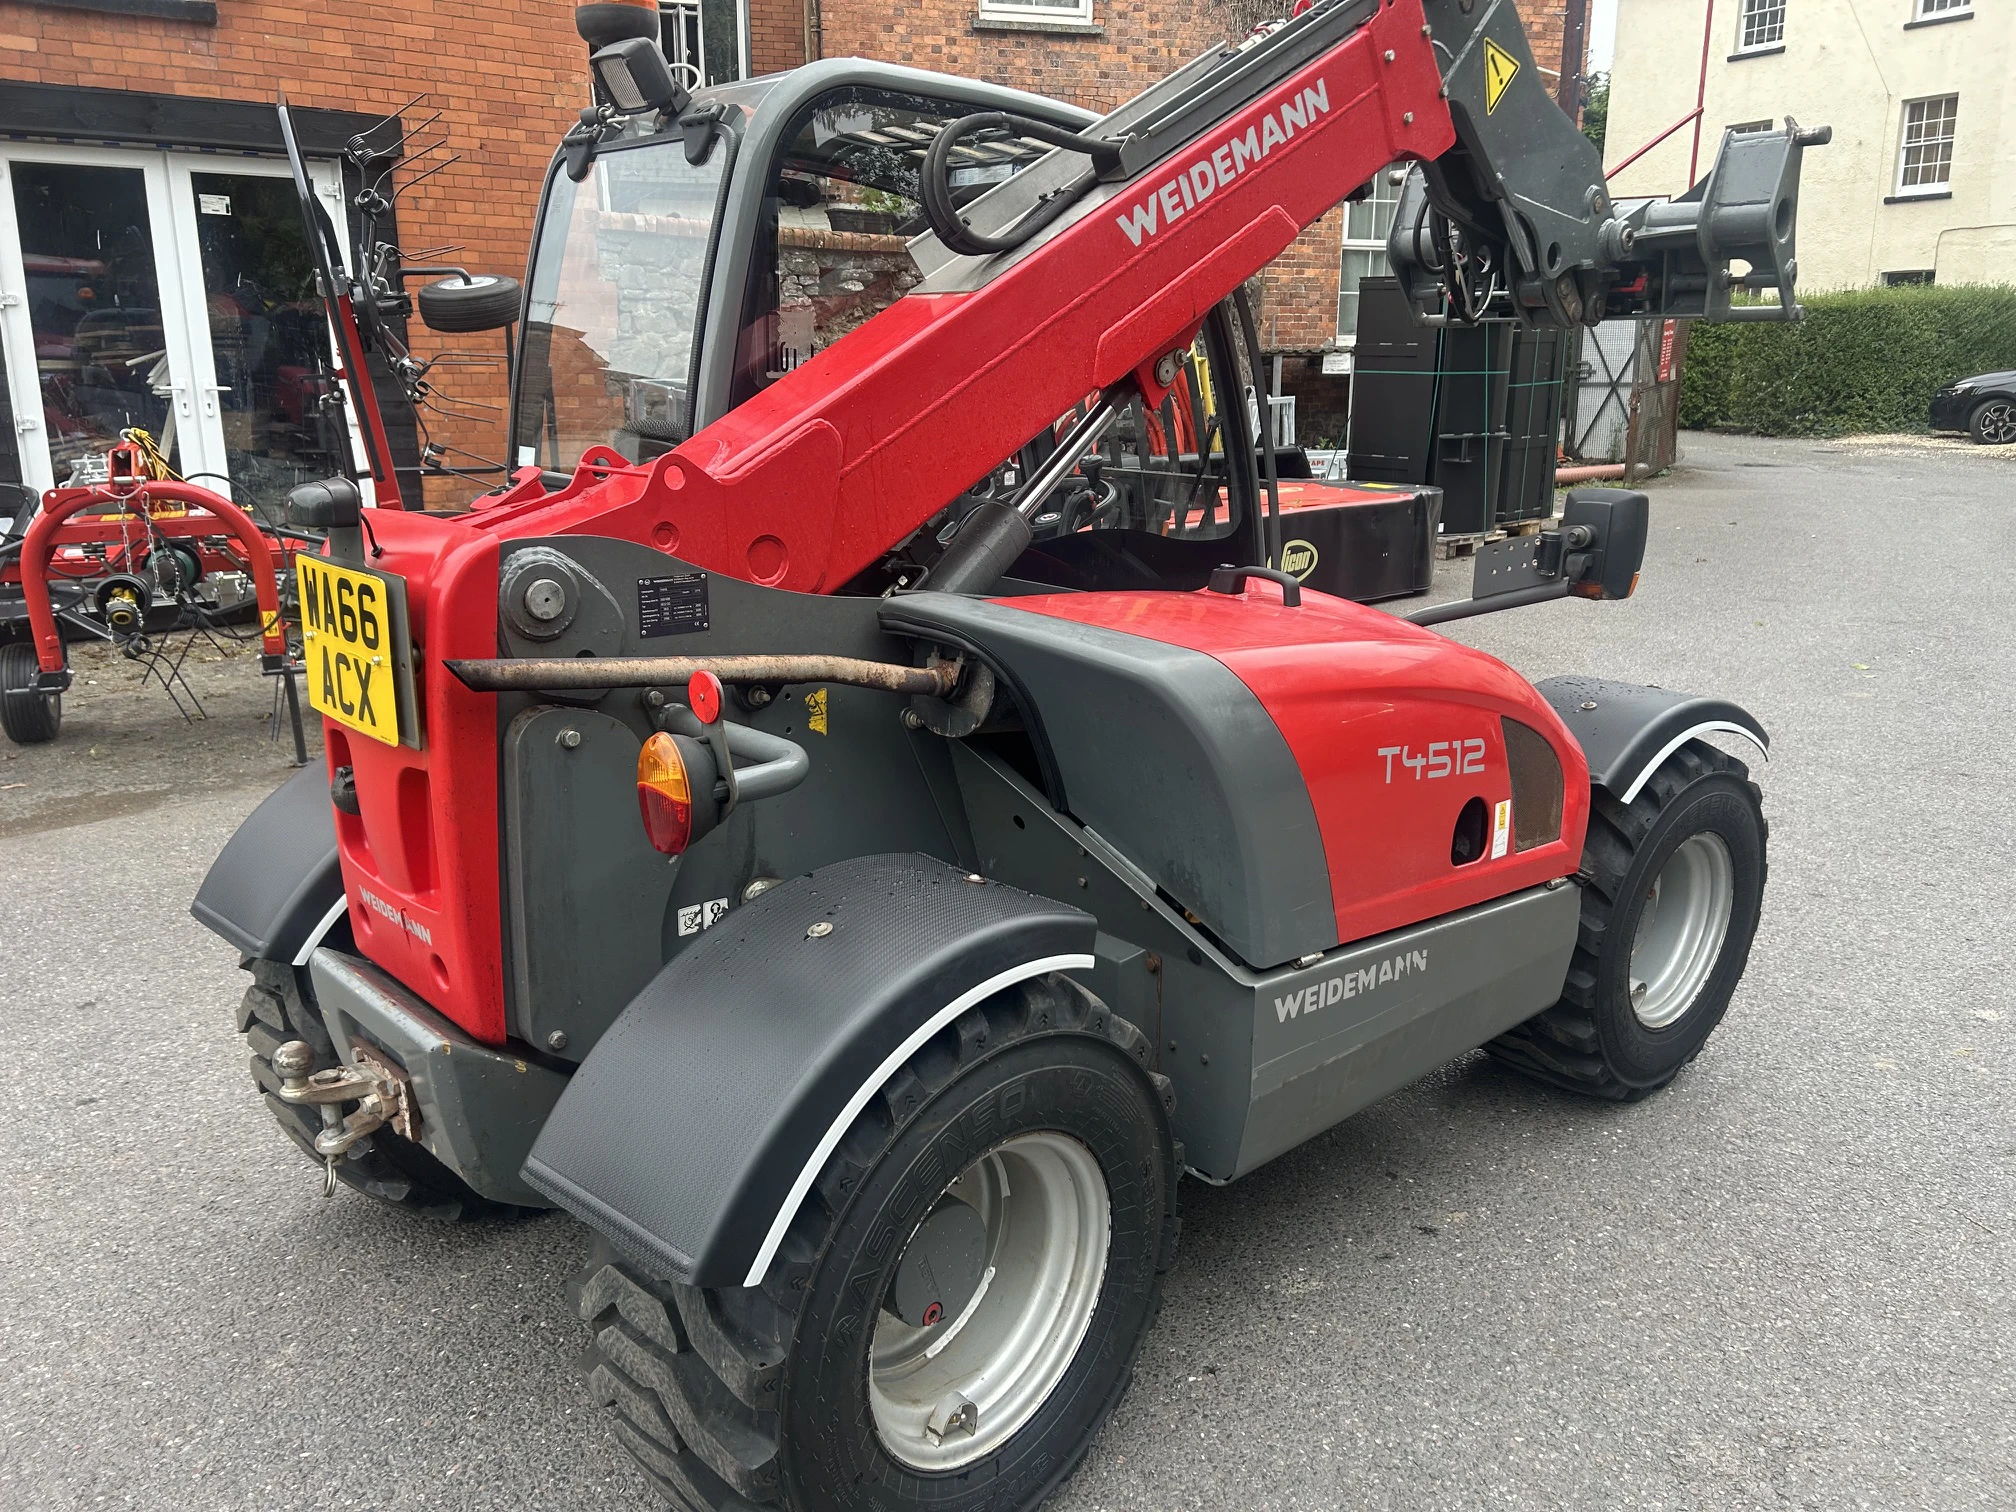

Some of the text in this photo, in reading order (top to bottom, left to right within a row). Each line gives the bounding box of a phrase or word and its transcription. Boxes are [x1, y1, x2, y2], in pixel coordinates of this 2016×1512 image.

[1115, 77, 1330, 247] WEIDEMANN
[302, 564, 380, 650] WA66
[322, 645, 377, 727] ACX
[1377, 737, 1486, 784] T4512
[358, 884, 433, 947] WEIDEMANN
[1274, 949, 1428, 1023] WEIDEMANN
[847, 1080, 1028, 1313] ASCENSO
